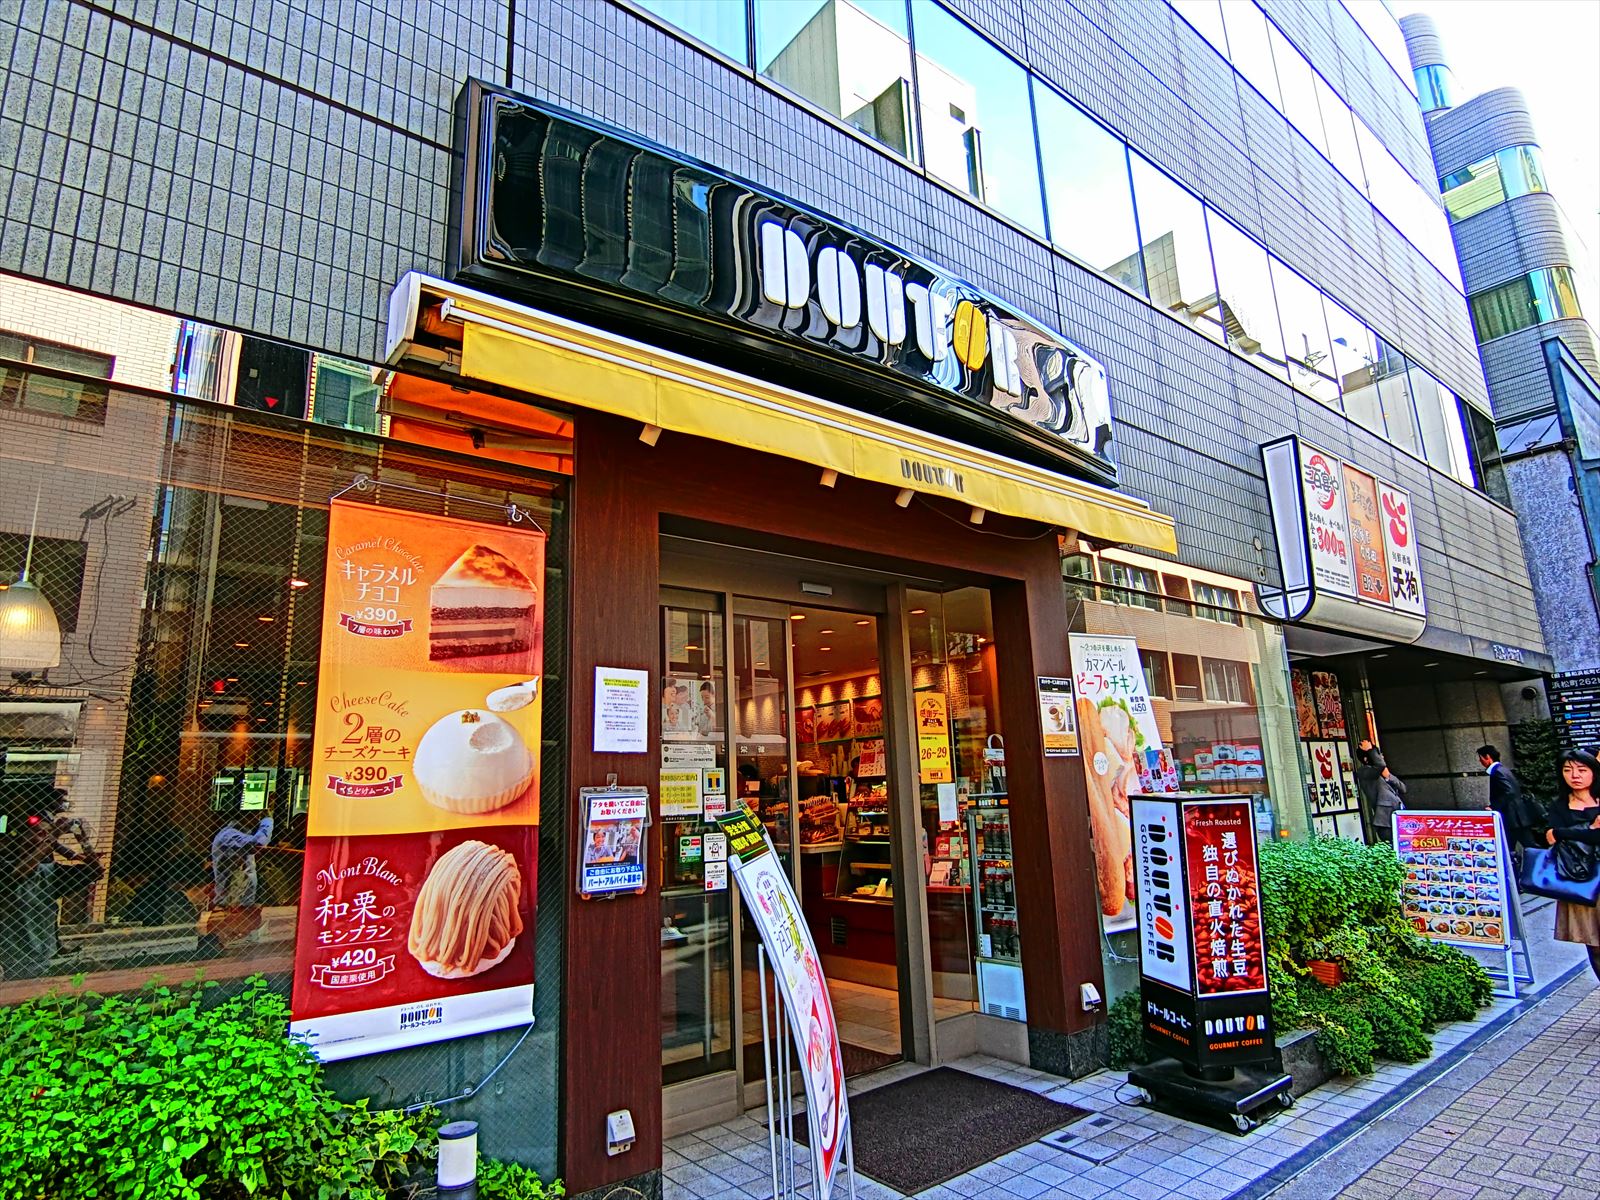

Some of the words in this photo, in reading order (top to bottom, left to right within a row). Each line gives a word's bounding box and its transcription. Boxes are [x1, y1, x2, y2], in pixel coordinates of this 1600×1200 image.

[761, 220, 1022, 397] DOUTOR
[900, 457, 965, 494] DOUTOR
[335, 537, 382, 560] Caramel
[383, 536, 425, 574] Chocolate
[341, 560, 417, 587] キャラメル
[1392, 566, 1420, 604] 天狗
[356, 582, 401, 603] チョコ
[356, 607, 398, 623] ¥390
[351, 624, 400, 637] 7層の味わい
[1085, 658, 1126, 672] カマンベール
[341, 712, 401, 745] 2層の
[324, 746, 411, 760] チーズケーキ
[345, 766, 388, 783] ¥390
[339, 785, 391, 796] くちどけムース
[1319, 781, 1342, 809] 天狗
[1195, 819, 1213, 827] Fresh
[1214, 817, 1242, 826] Roasted
[1426, 819, 1494, 829] ランチメニュー
[1140, 824, 1152, 896] GOURMET
[316, 859, 362, 892] Mont
[362, 856, 402, 887] Blanc
[1147, 823, 1175, 964] DOUTOR
[1220, 831, 1249, 977] 選びぬかれた生豆
[314, 890, 395, 927] 和栗の
[1202, 845, 1229, 978] 独自の直火焙煎
[317, 925, 393, 944] モンブラン
[1145, 902, 1156, 957] COFFEE
[331, 948, 377, 968] ¥420
[400, 1007, 443, 1024] DOUTOR
[1147, 1000, 1192, 1029] ドトールコーヒー
[1204, 1014, 1266, 1036] DOUTOR
[1150, 1022, 1172, 1037] GOURMET
[1172, 1031, 1190, 1046] COFFEE
[1209, 1040, 1240, 1050] GOURMET
[1241, 1038, 1264, 1047] COFFEE
